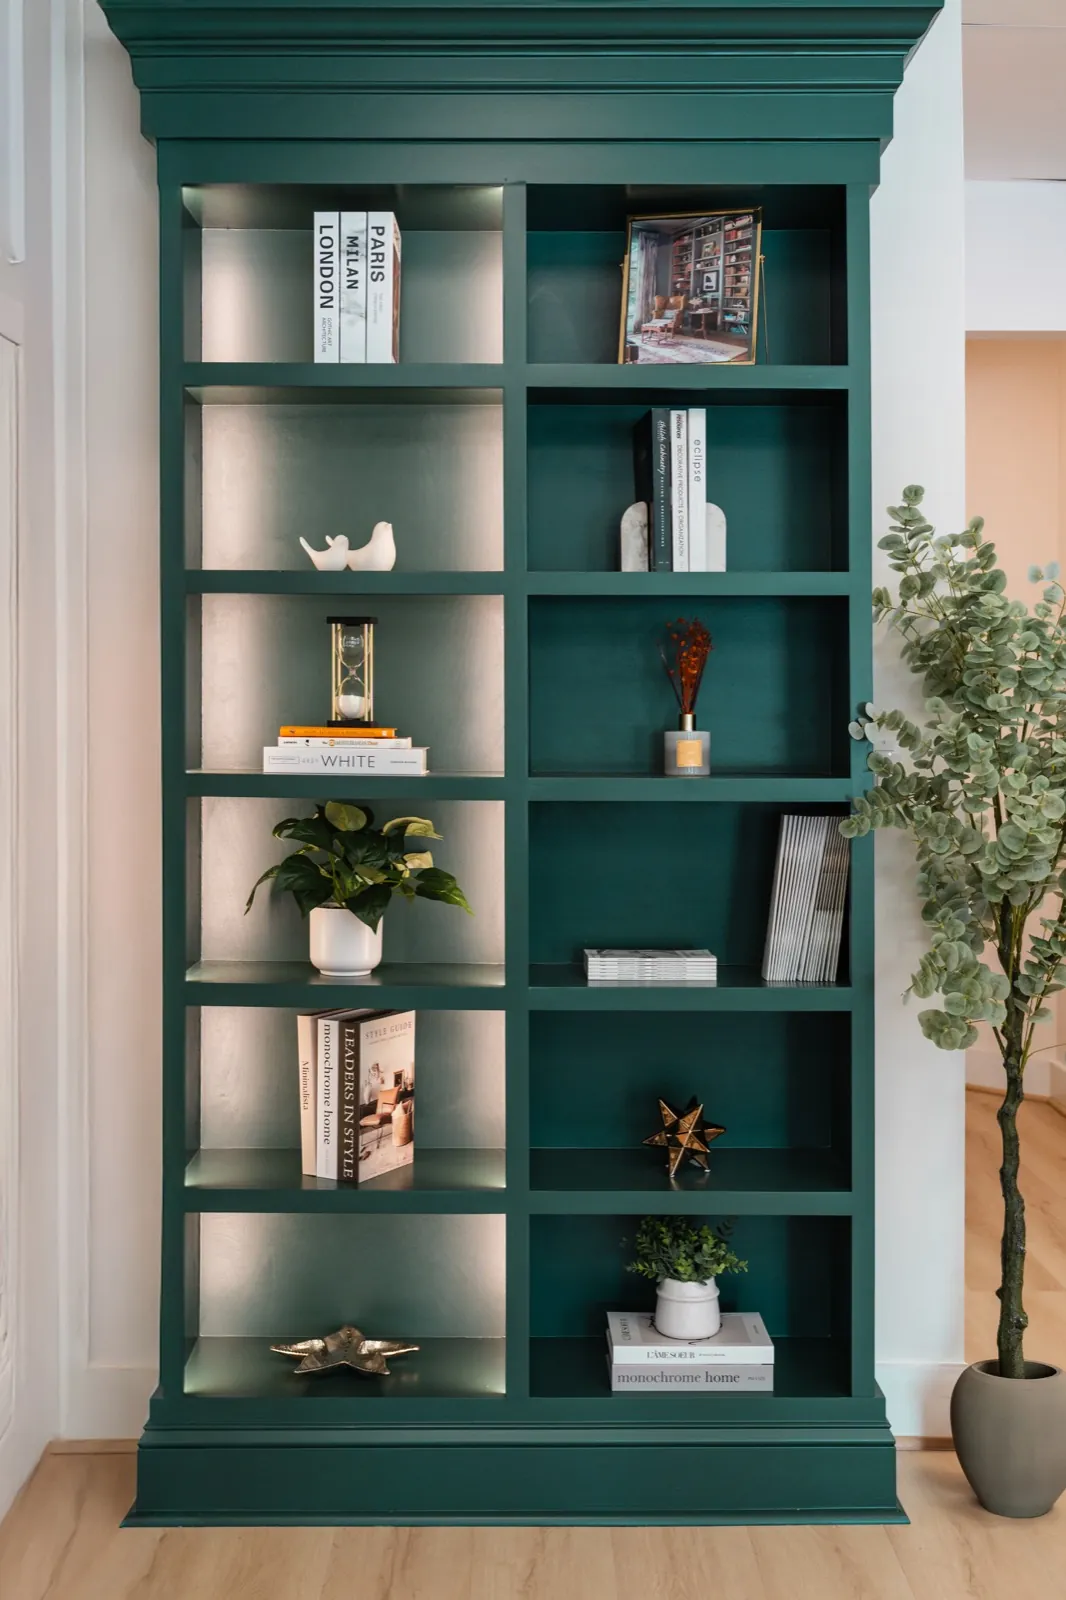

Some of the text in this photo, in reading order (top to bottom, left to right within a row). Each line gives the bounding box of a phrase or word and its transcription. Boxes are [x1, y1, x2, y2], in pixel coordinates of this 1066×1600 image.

[319, 225, 334, 309] LONDON
[346, 236, 359, 289] MILAN
[370, 226, 385, 283] PARIS
[693, 439, 703, 482] eclipse
[321, 755, 375, 768] WHITE
[389, 1021, 412, 1033] GUIDE
[323, 1023, 334, 1107] monochrome
[343, 1027, 356, 1178] LEADERS IN STYLE
[323, 1109, 333, 1145] home
[617, 1371, 701, 1383] monochrome
[704, 1371, 740, 1383] home
